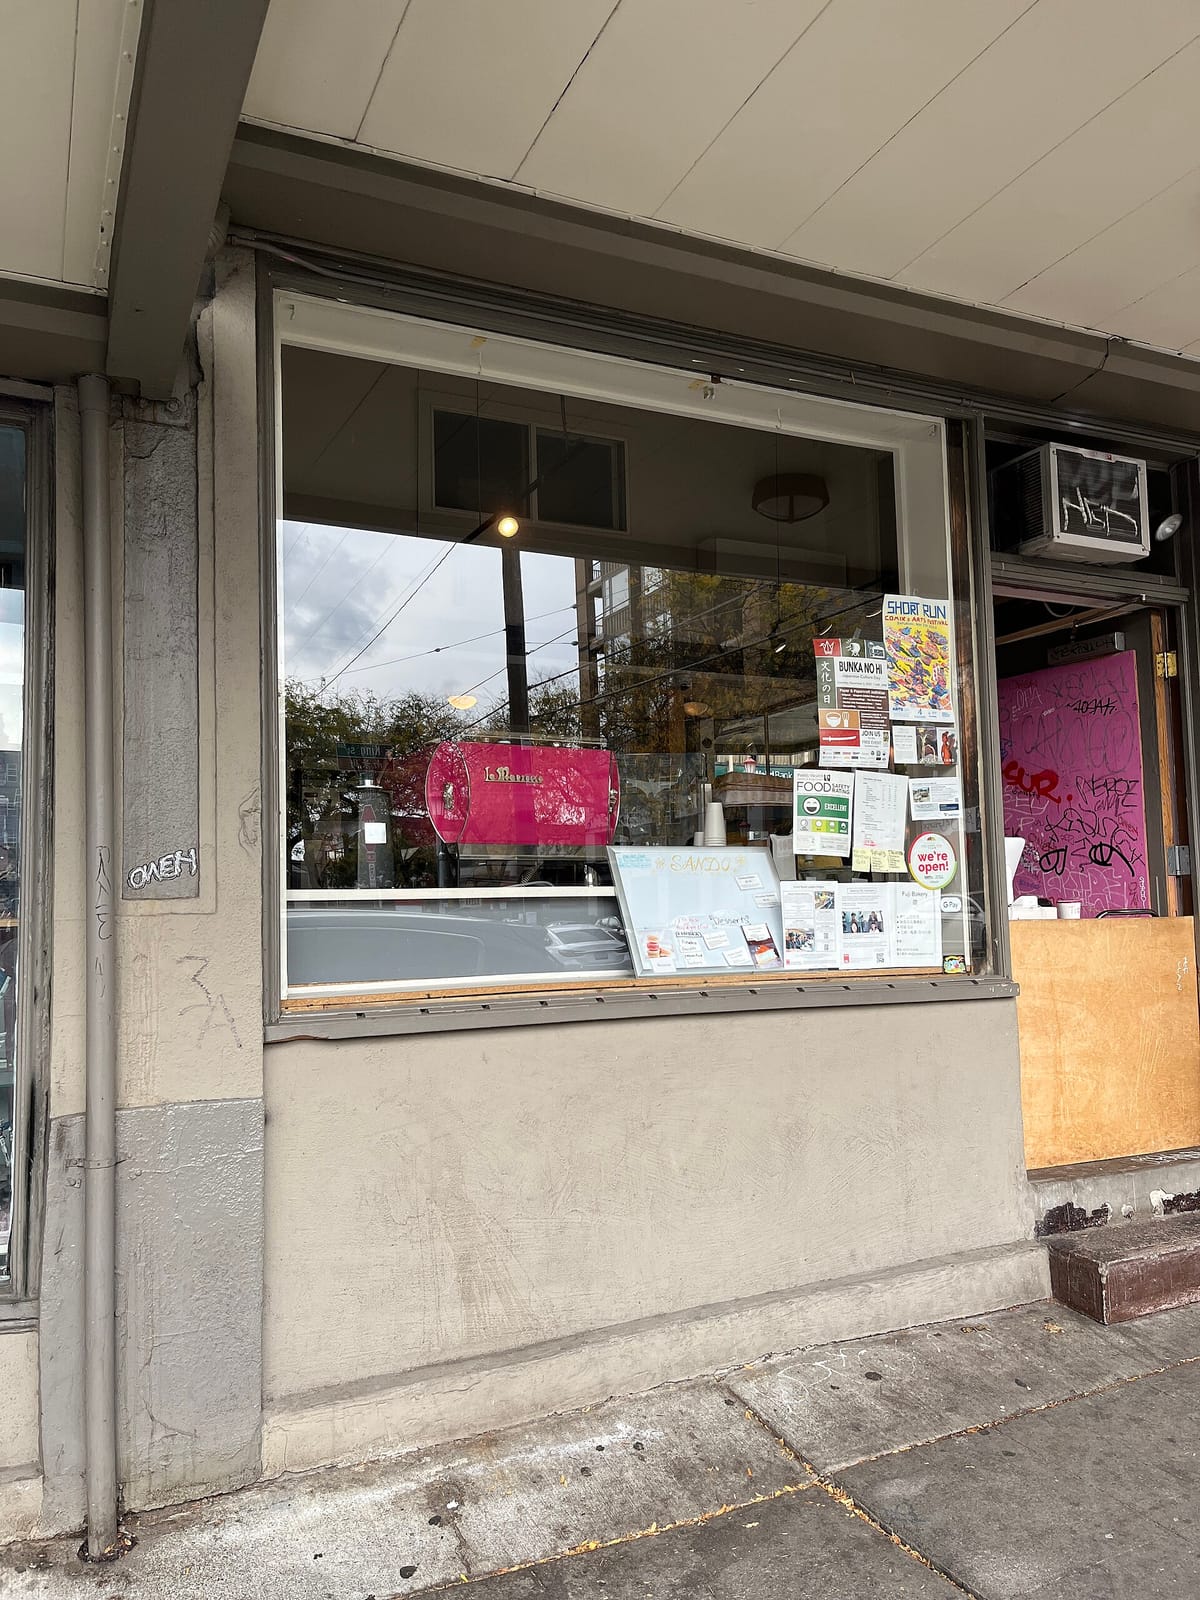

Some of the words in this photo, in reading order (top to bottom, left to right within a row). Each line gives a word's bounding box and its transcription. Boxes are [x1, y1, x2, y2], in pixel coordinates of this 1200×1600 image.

[887, 600, 920, 616] SHORT
[922, 604, 946, 620] RUN
[911, 616, 927, 624] ARTS
[838, 661, 864, 673] BUNKA
[864, 662, 875, 674] NO
[875, 664, 883, 675] HI
[820, 661, 832, 704] 文化の日
[796, 781, 832, 792] FOOD
[670, 854, 731, 872] SANDO
[917, 850, 948, 862] we're
[917, 860, 949, 875] open!
[942, 901, 948, 909] G
[949, 901, 959, 910] Pay
